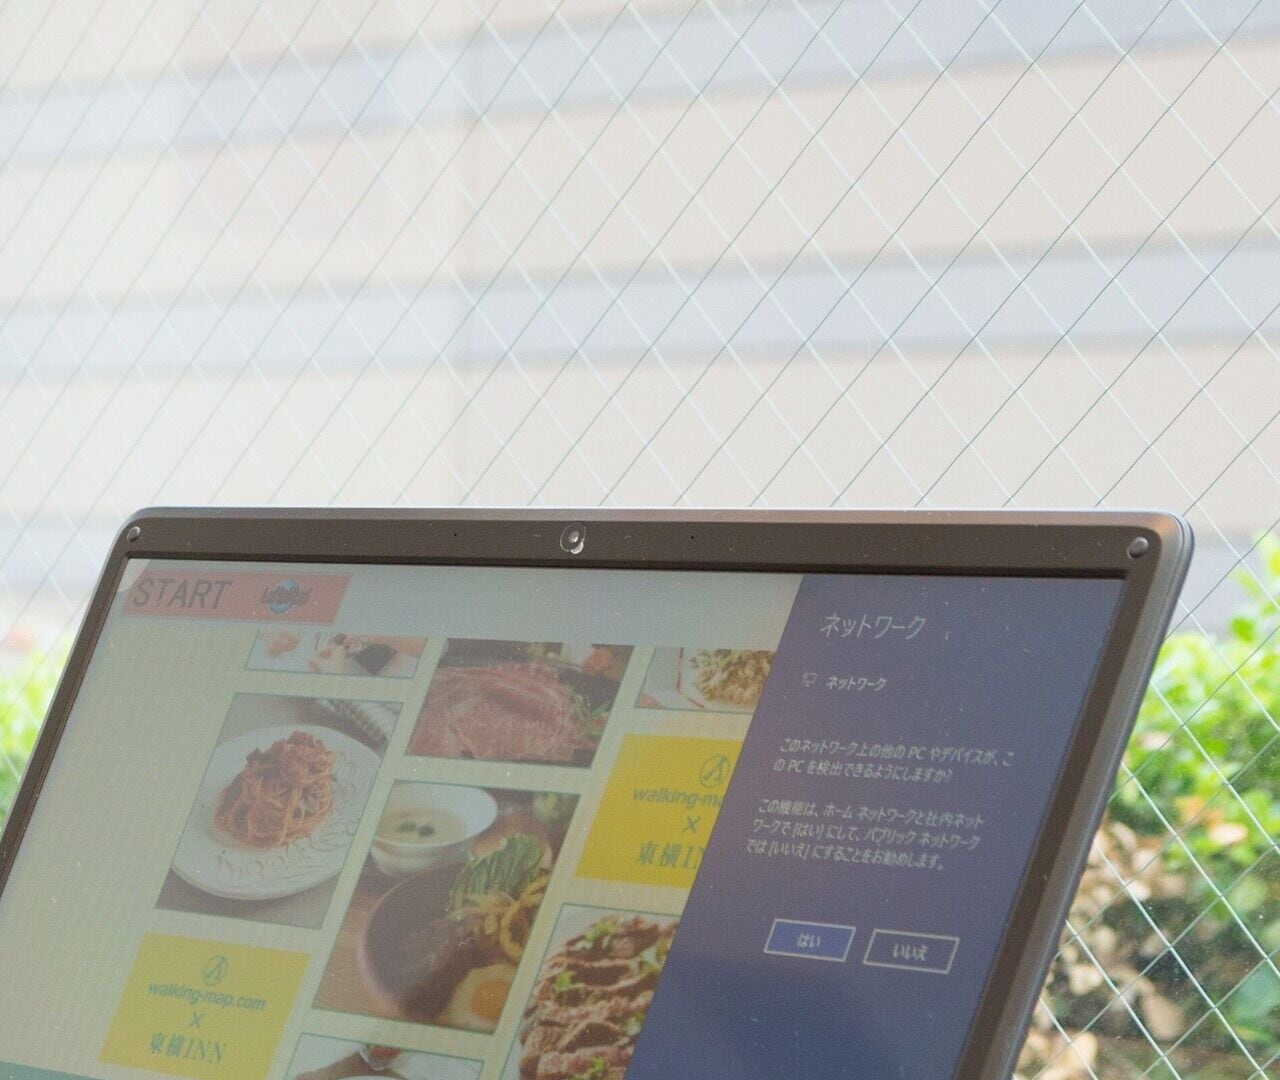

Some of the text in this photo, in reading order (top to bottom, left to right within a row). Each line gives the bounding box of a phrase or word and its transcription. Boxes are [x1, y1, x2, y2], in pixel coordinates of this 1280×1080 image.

[132, 578, 233, 610] START
[820, 613, 926, 640] ネットワーク
[826, 675, 887, 692] ネットワーク
[148, 981, 266, 1010] walking-map.com
[149, 1031, 229, 1063] 東横INN
